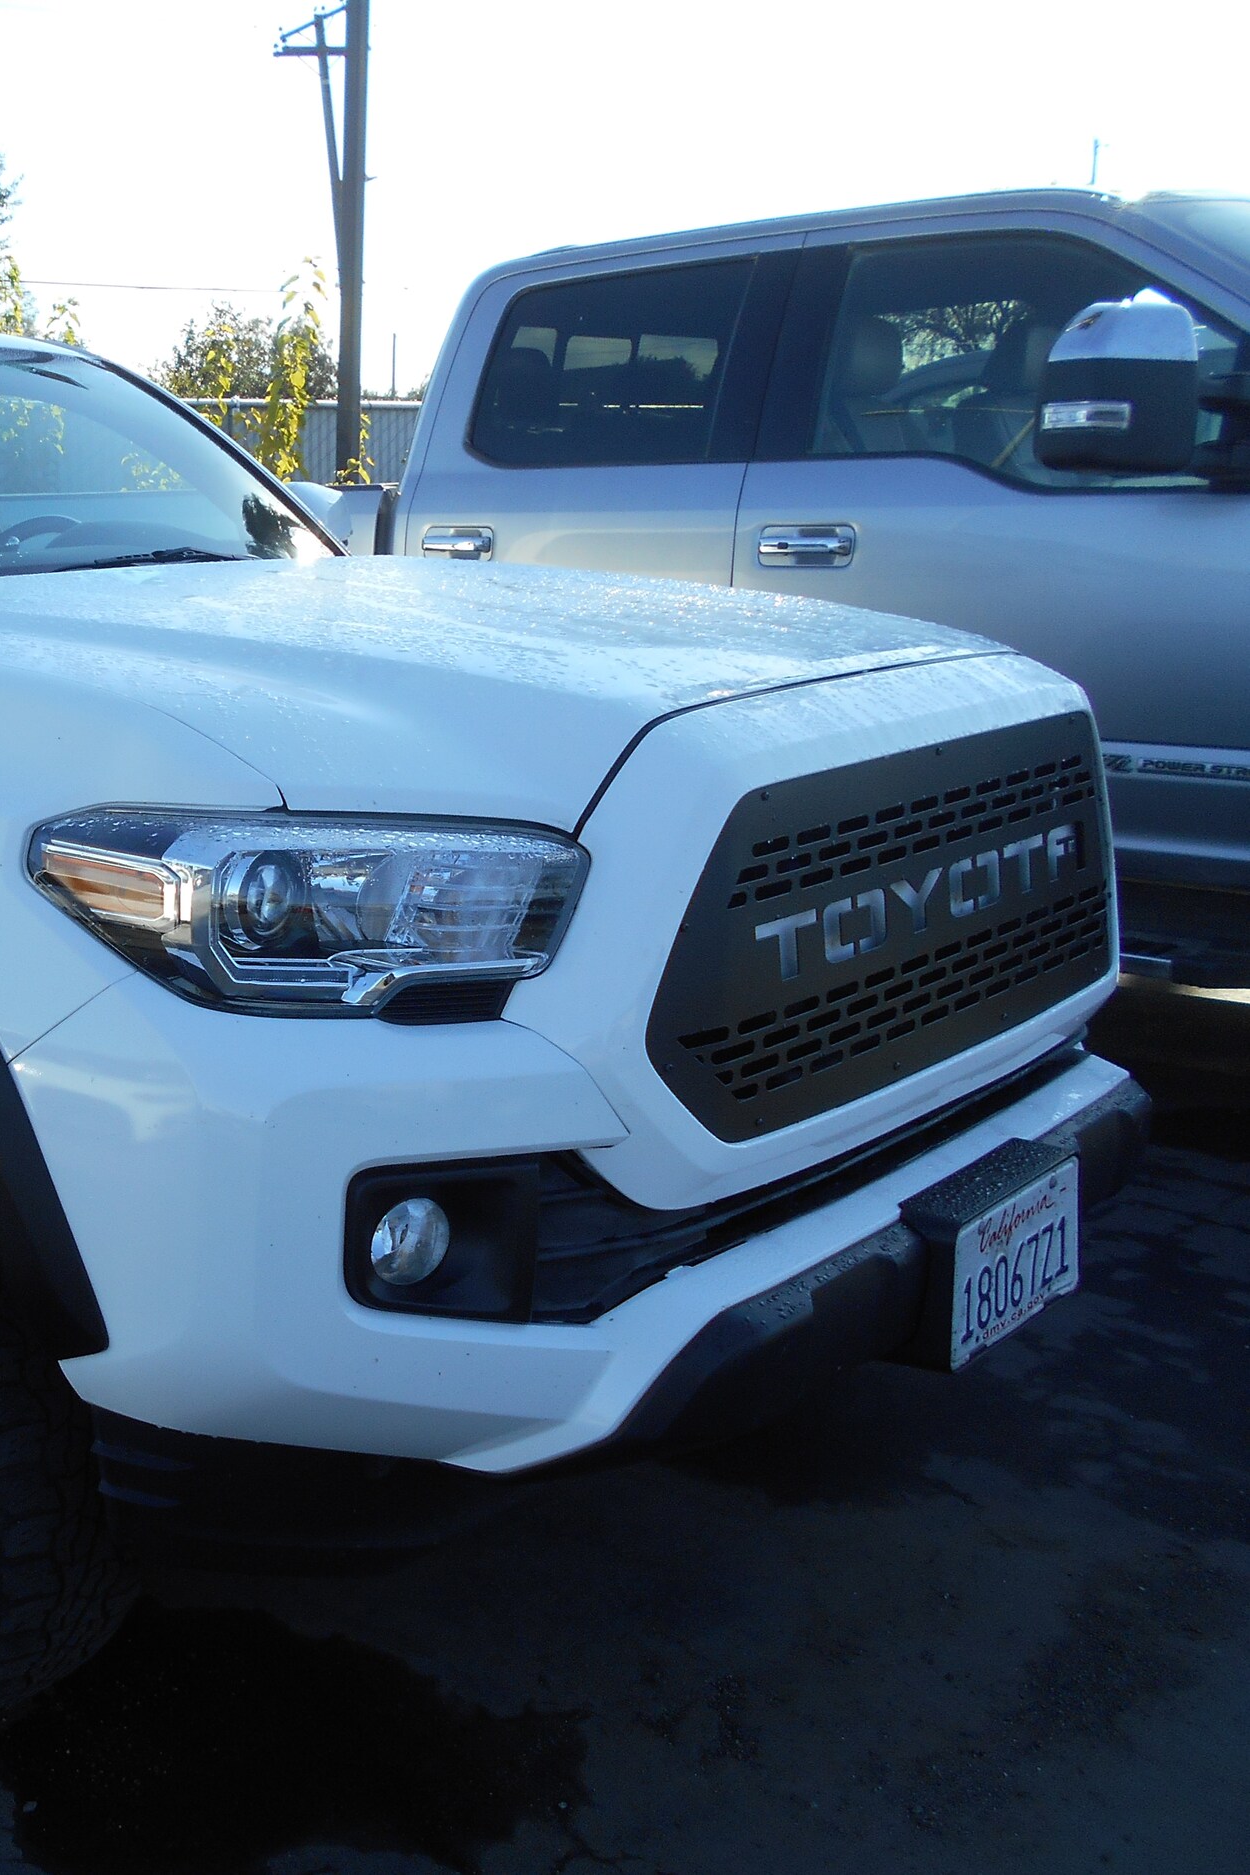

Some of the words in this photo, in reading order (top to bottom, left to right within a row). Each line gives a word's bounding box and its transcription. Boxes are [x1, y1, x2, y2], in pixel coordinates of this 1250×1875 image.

[1141, 758, 1207, 774] POWER
[755, 821, 1085, 981] TOYOTA
[978, 1194, 1055, 1253] California
[982, 1291, 1046, 1341] dmv.ca.gov
